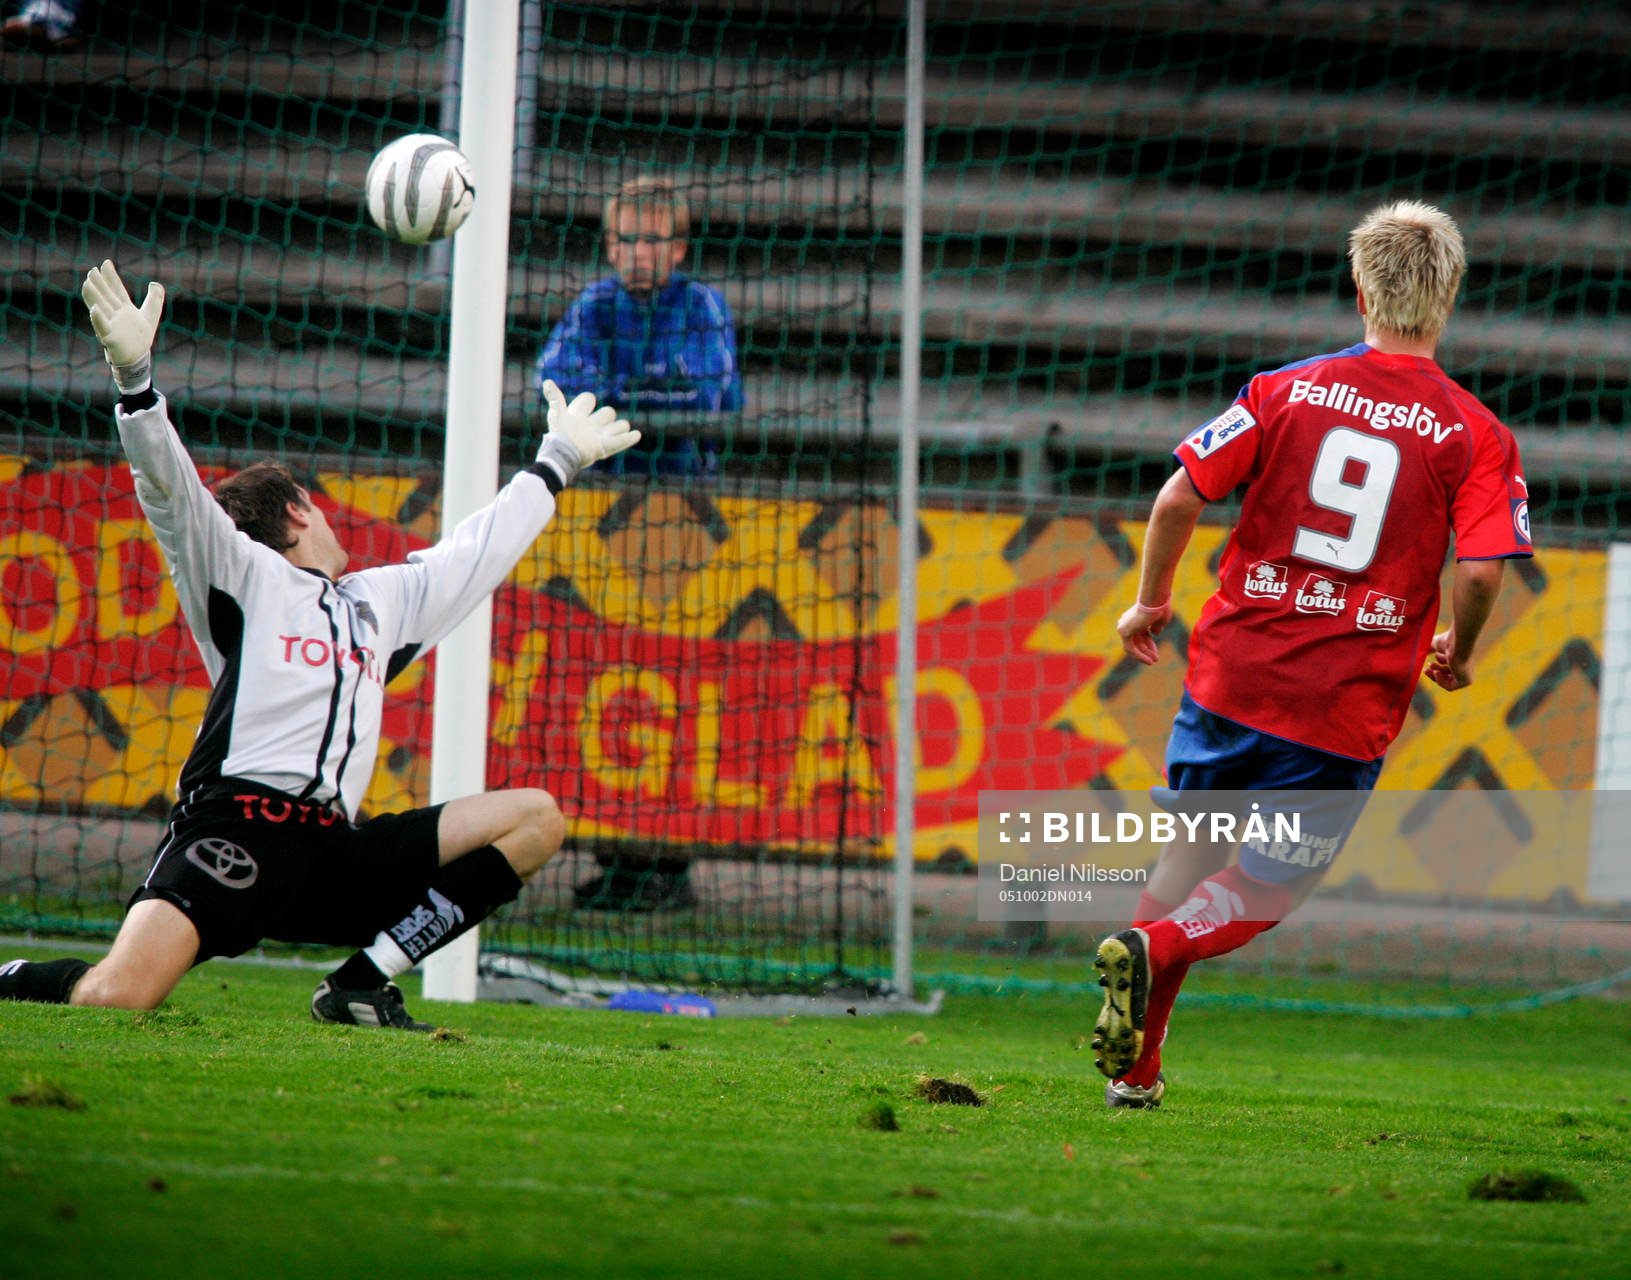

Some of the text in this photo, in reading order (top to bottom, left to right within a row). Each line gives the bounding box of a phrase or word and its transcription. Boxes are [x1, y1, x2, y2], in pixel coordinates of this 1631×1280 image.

[1218, 417, 1247, 440] SPORT
[1292, 426, 1400, 573] 9
[1244, 573, 1288, 594] lotus
[1295, 589, 1347, 610] lotus
[1356, 607, 1406, 626] lotus
[579, 664, 985, 809] GLAD
